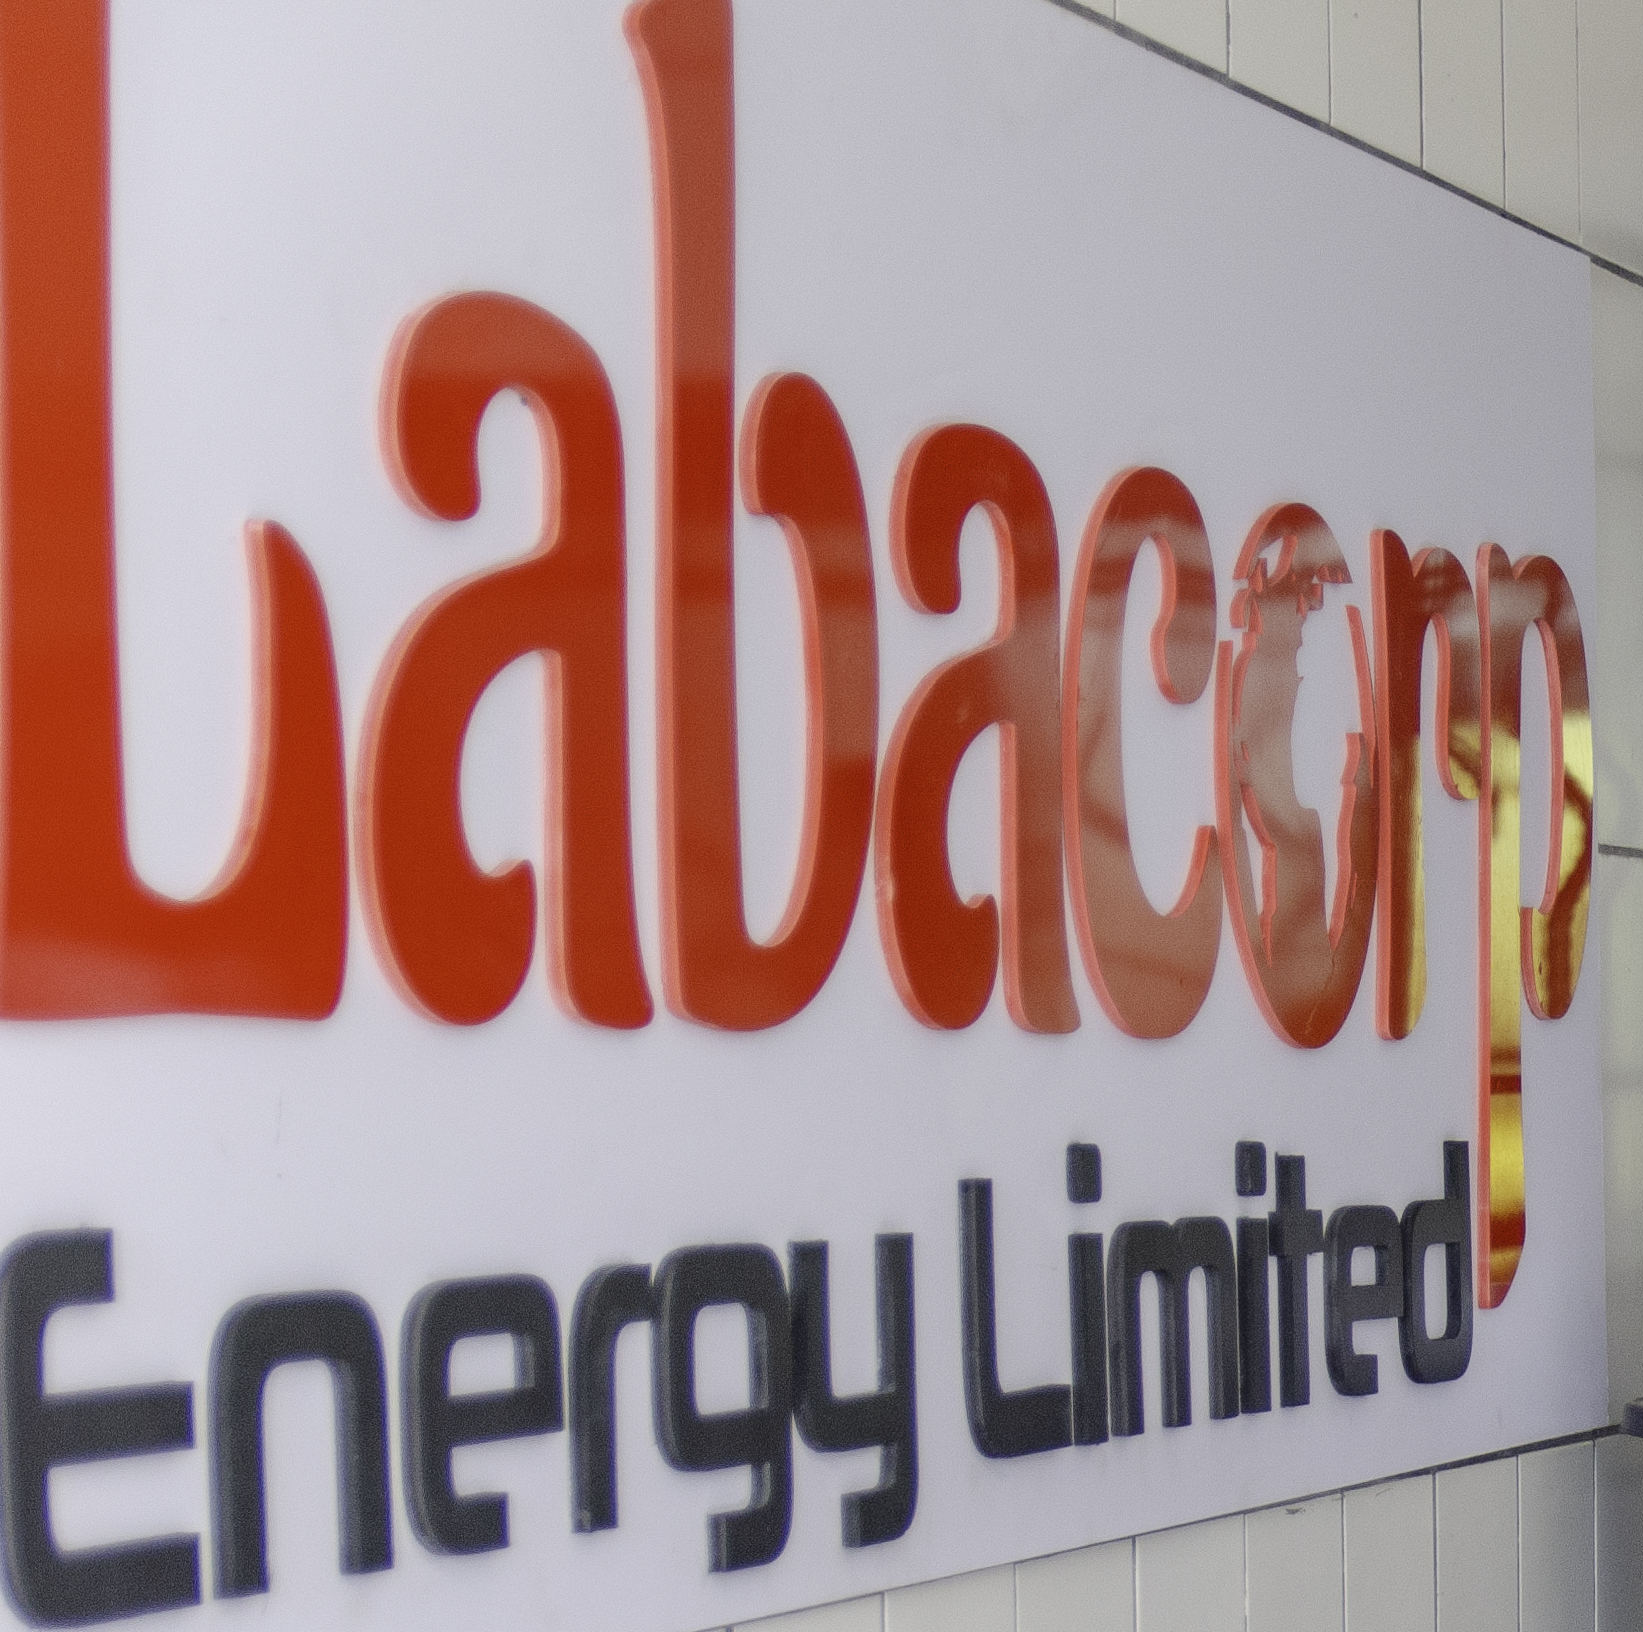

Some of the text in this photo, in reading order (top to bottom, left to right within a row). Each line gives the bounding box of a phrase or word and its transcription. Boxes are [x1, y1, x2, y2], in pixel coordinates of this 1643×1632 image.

[0, 0, 1594, 1309] Labacorp
[0, 1140, 1470, 1632] Energy Limited
